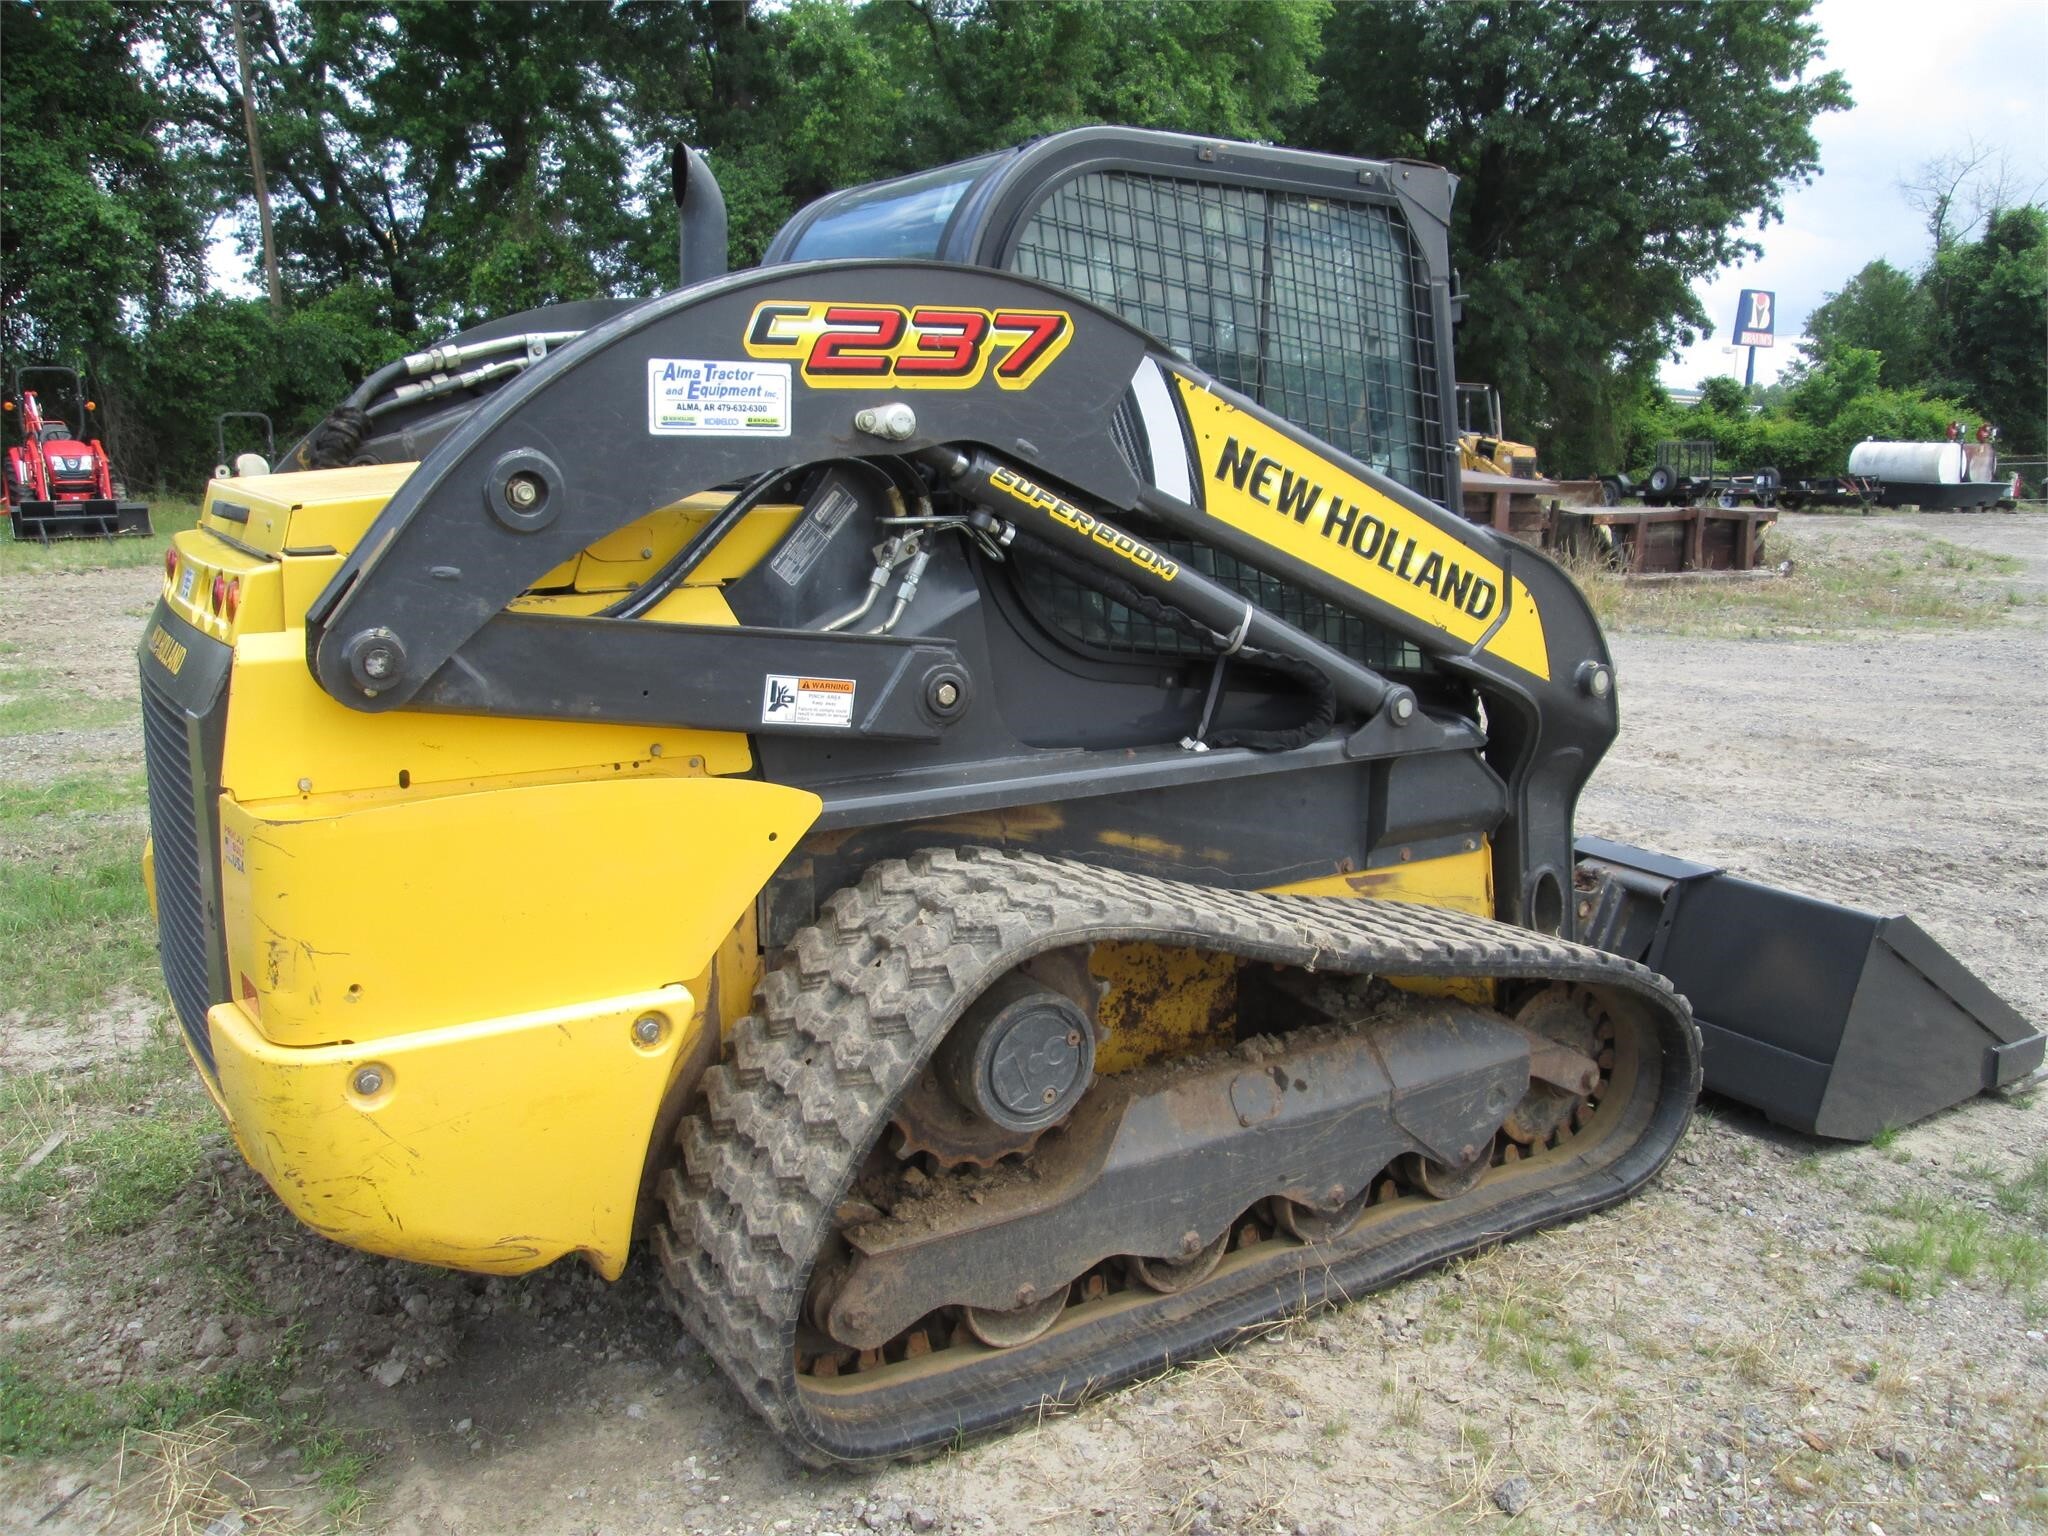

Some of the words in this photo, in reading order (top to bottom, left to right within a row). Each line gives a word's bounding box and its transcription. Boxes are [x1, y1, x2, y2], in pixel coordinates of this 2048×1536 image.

[748, 304, 1070, 380] C237
[663, 362, 701, 381] Alma
[703, 363, 755, 382] Tractor
[665, 387, 683, 396] and
[687, 380, 762, 400] Equipment
[676, 403, 702, 412] ALMA,
[717, 404, 768, 413] 479-632-6300
[992, 468, 1095, 532] SUPER
[1094, 523, 1179, 579] BOOM
[1214, 435, 1324, 525] NEW
[1320, 495, 1498, 621] HOLLAND
[812, 682, 850, 691] WARNING
